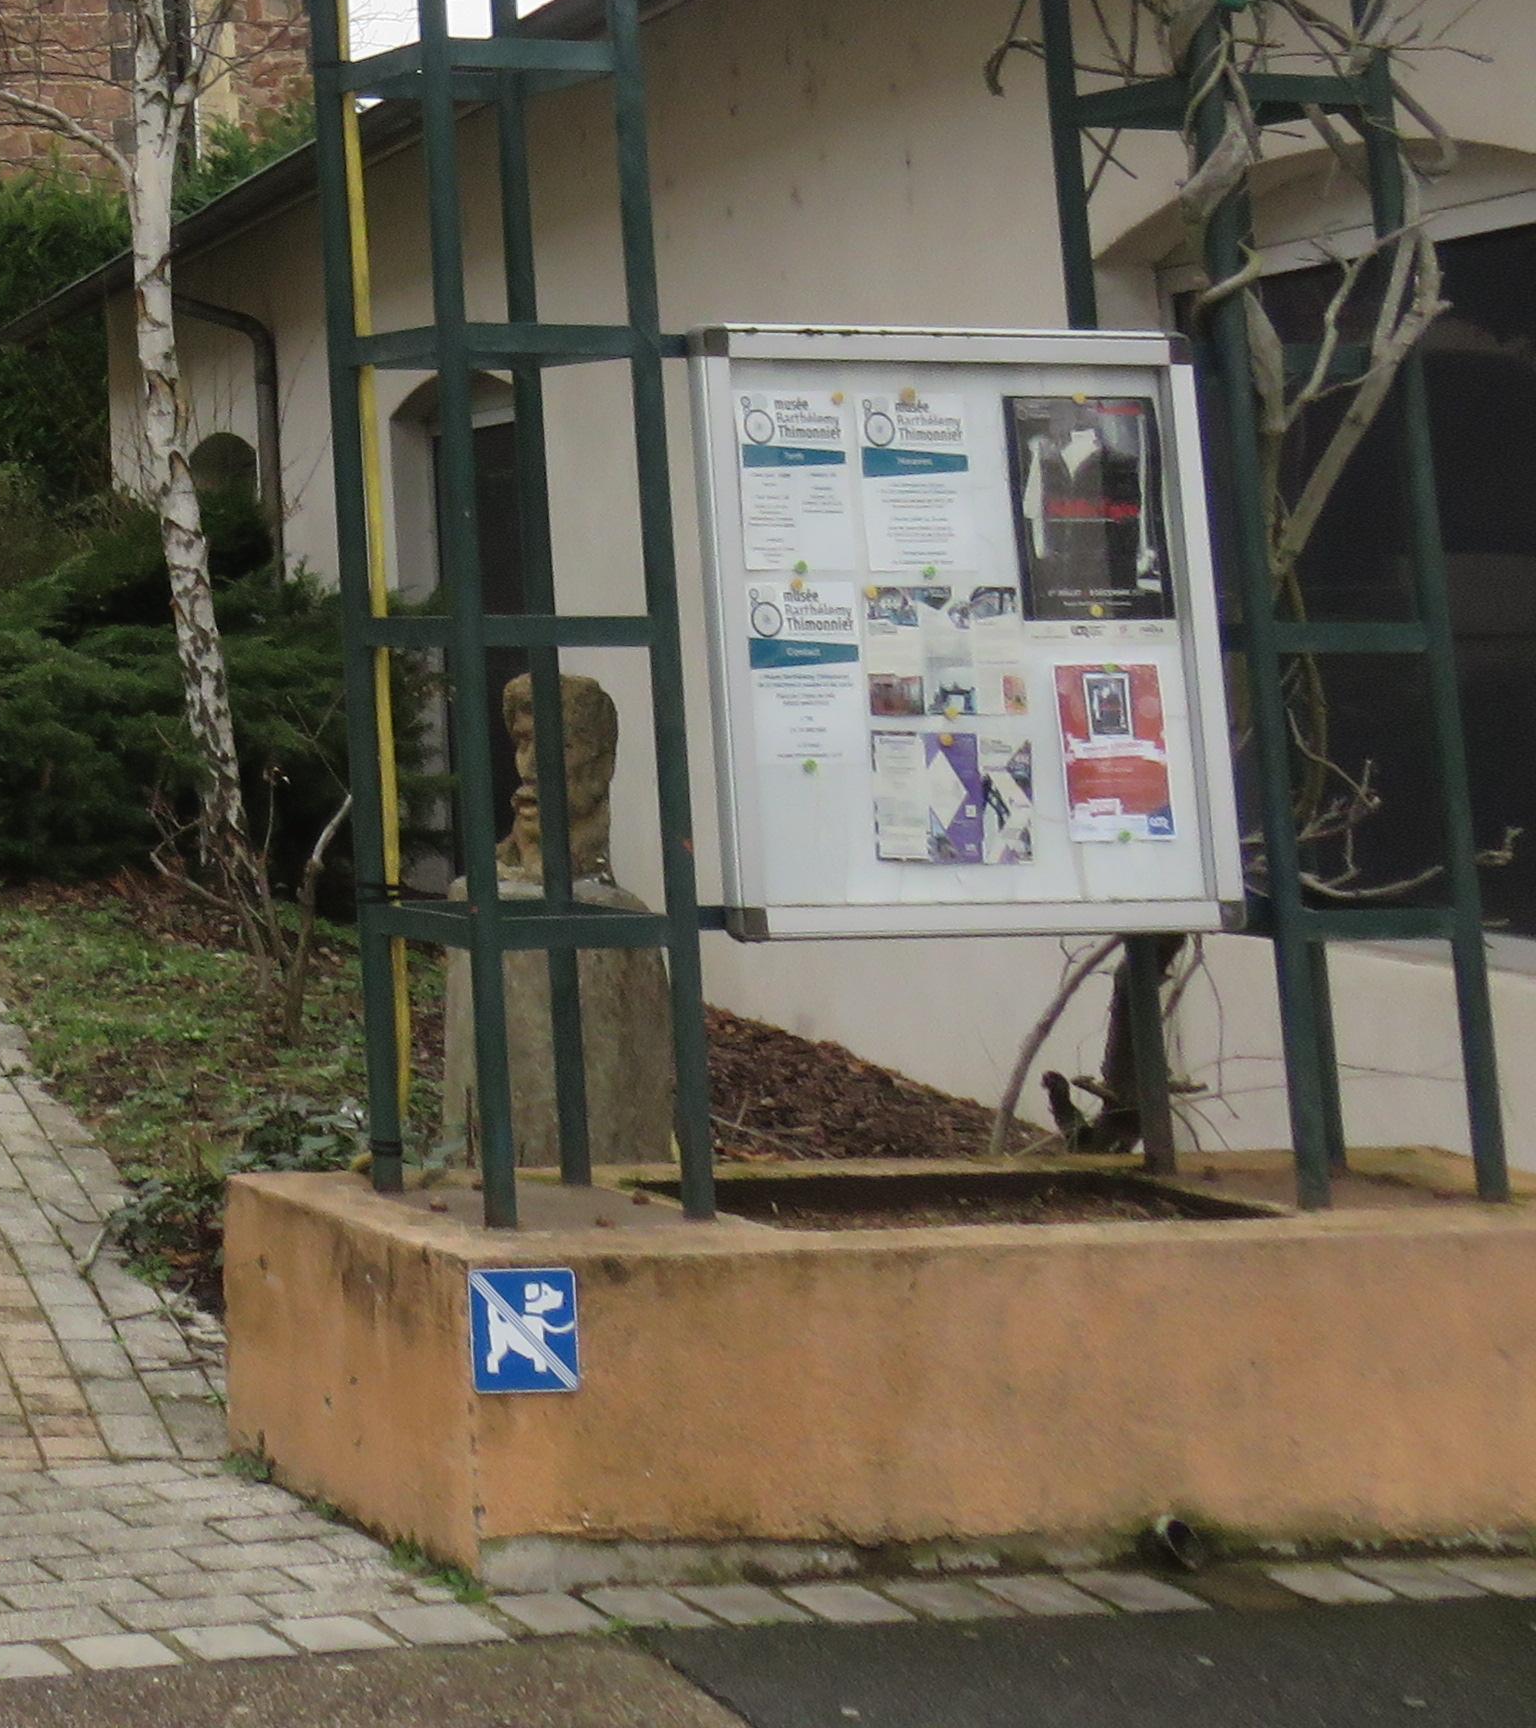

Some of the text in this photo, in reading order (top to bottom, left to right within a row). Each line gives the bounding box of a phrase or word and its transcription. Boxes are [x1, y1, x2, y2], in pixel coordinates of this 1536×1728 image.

[774, 397, 809, 410] musée
[778, 425, 842, 440] Thimonnier
[898, 427, 963, 442] Thimonnier
[787, 617, 855, 632] Thimonnier
